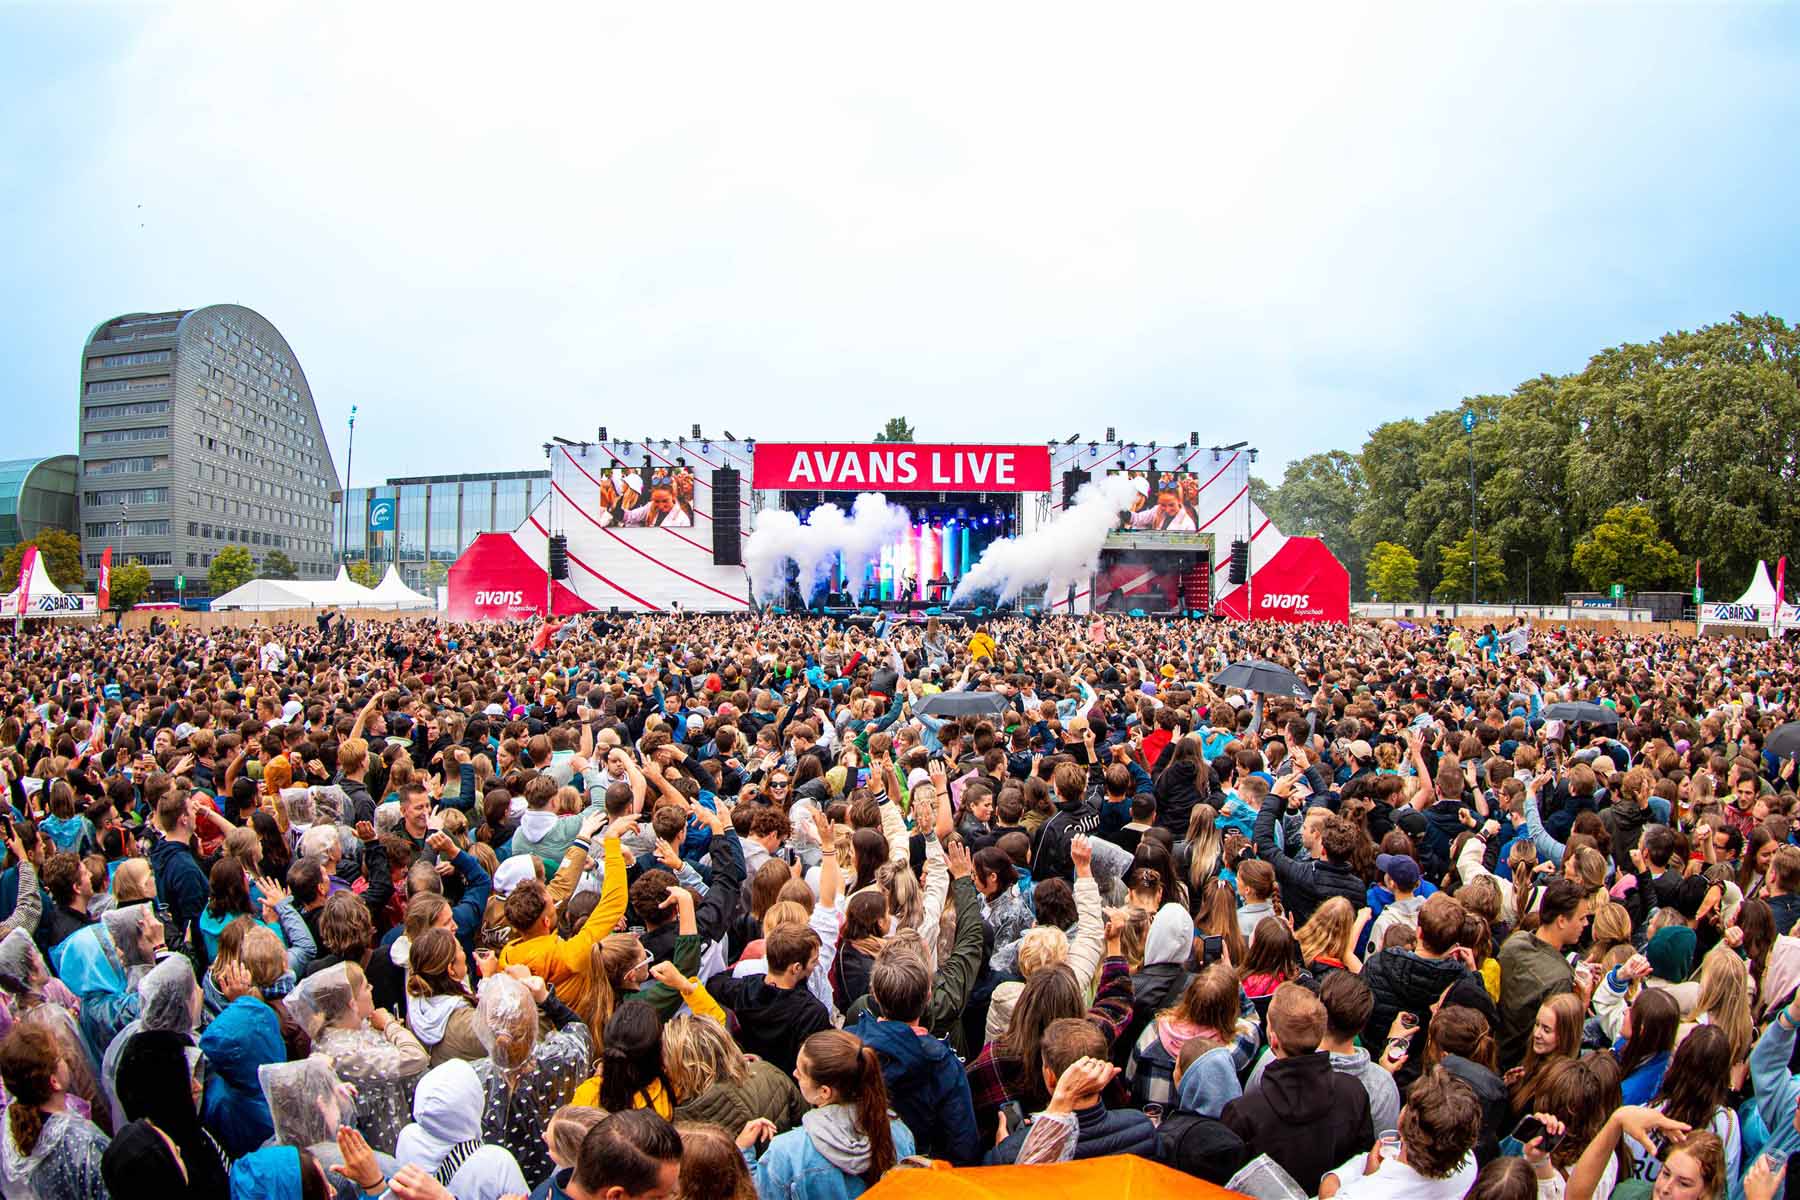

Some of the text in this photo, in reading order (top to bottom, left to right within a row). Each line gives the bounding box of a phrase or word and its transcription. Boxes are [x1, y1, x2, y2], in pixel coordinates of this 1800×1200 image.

[787, 451, 1016, 485] AVANS LIVE
[54, 597, 69, 610] BAR
[474, 590, 523, 605] avans
[1261, 593, 1310, 608] avans
[1729, 606, 1744, 619] BAR
